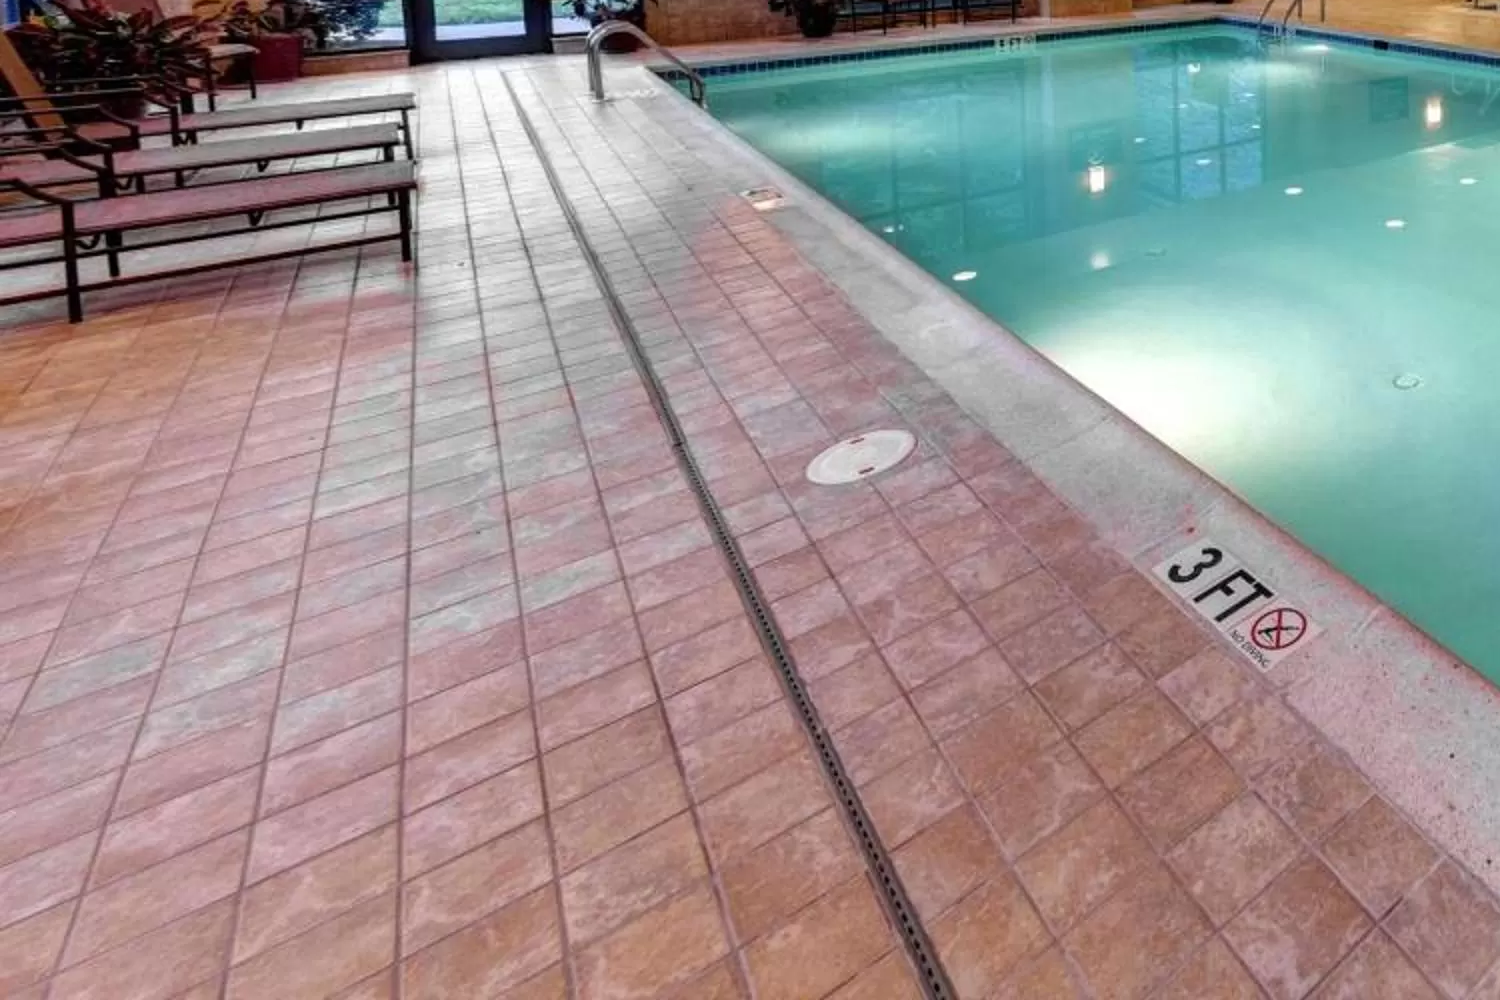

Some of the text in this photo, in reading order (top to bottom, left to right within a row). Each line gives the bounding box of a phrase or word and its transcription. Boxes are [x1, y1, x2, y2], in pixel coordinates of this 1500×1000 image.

[1168, 548, 1274, 623] 3 FT
[1231, 630, 1245, 643] NO
